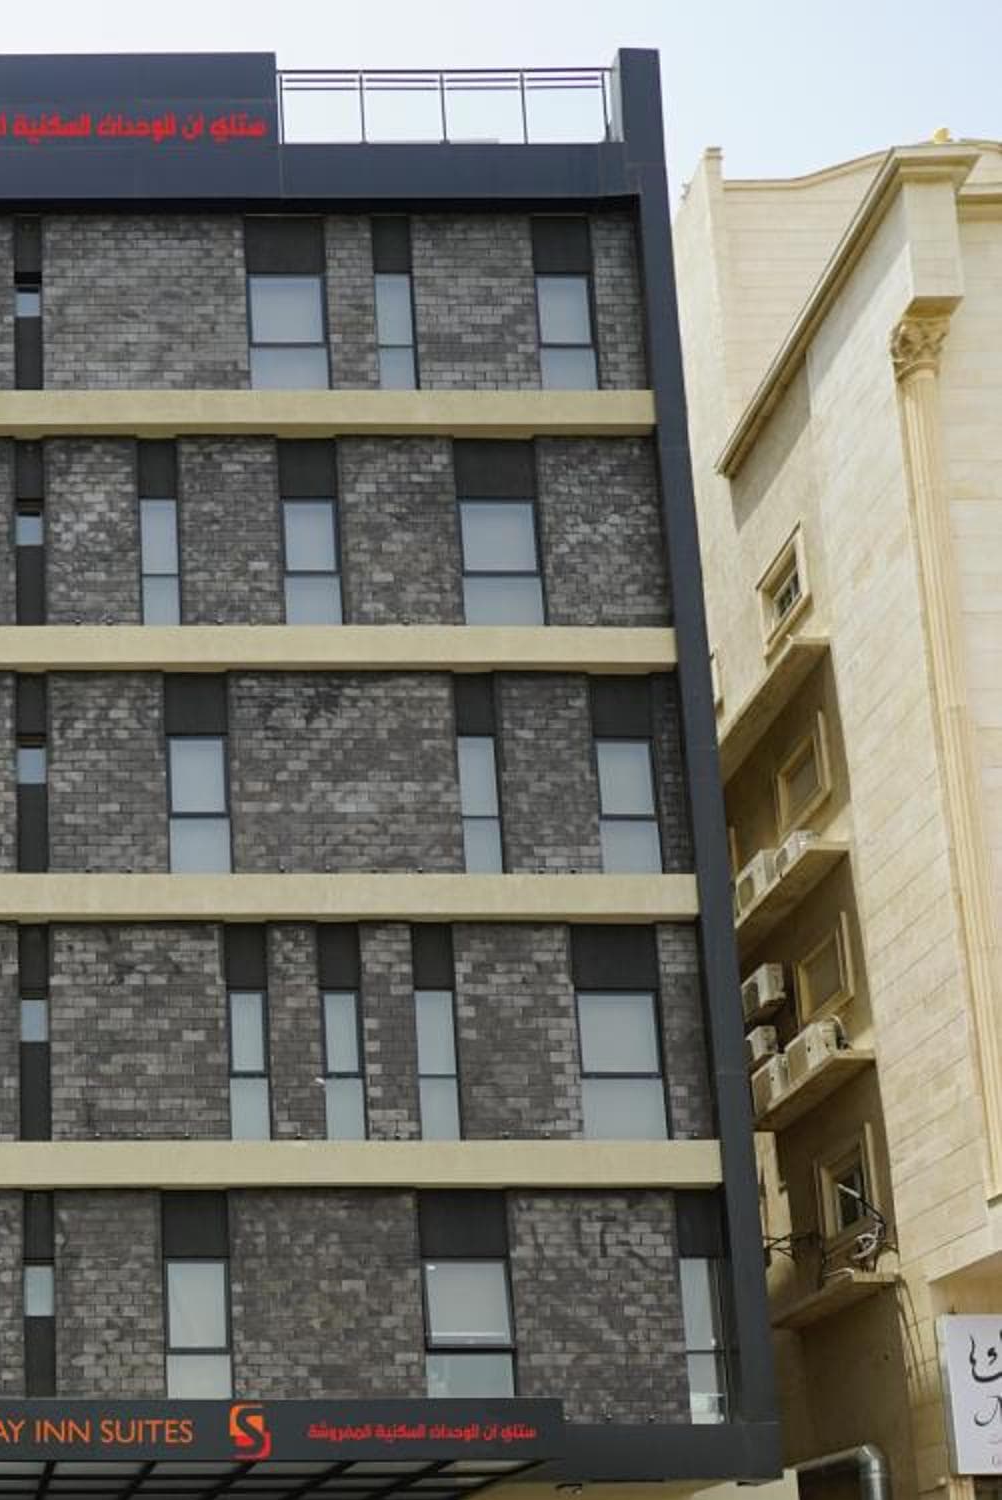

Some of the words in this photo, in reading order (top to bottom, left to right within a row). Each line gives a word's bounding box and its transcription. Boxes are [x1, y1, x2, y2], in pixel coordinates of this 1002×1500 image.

[12, 110, 91, 144] السكنية
[35, 1419, 91, 1443] INN
[100, 1419, 194, 1444] SUITES
